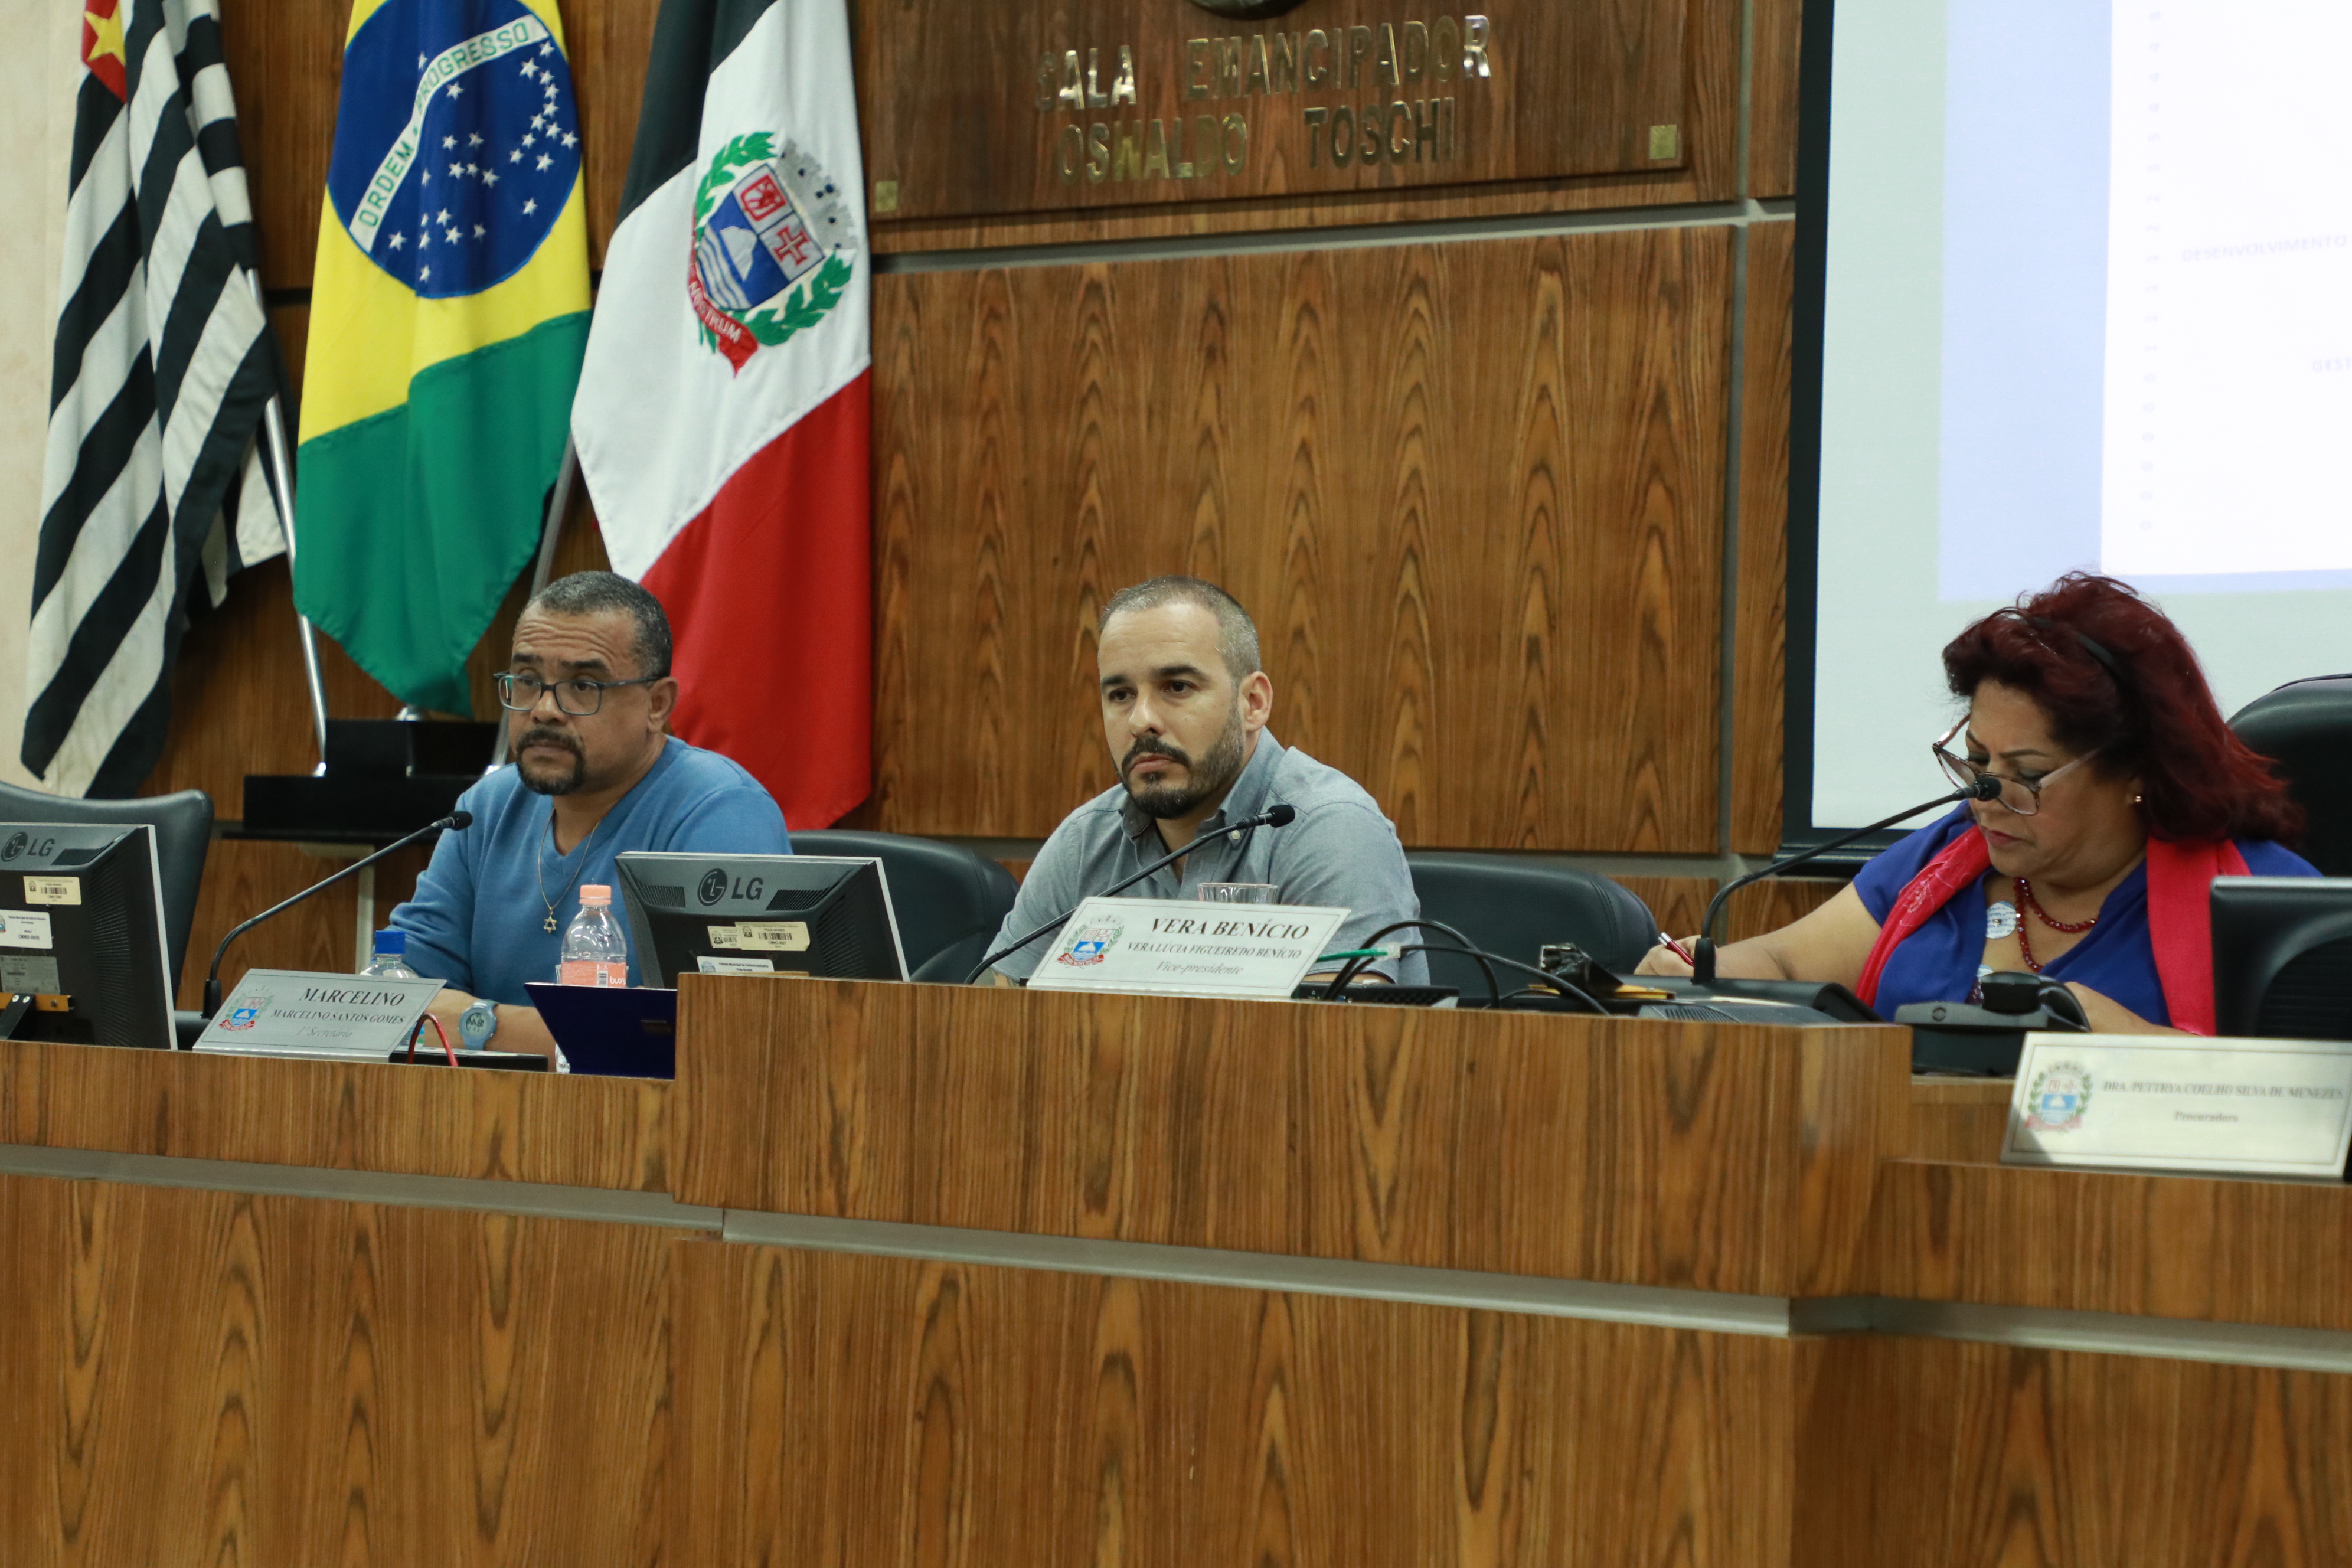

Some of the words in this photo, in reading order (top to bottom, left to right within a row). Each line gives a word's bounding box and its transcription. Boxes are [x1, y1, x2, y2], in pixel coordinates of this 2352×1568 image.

[1035, 45, 1137, 111] SALA
[1187, 14, 1492, 100] EMANCIPADOR
[358, 140, 414, 228] ORDEM
[415, 22, 530, 116] PROGRESSO
[1057, 112, 1247, 185] OSWALDO
[1304, 97, 1455, 169] TOSCHI
[2181, 234, 2347, 262] DESENVOLVIMENTO
[688, 280, 742, 344] NOSTRUM
[27, 838, 55, 857] LG
[731, 877, 764, 901] LG
[1152, 917, 1208, 936] VERA
[1212, 918, 1310, 940] BENÍCIO
[1128, 942, 1154, 952] VERA
[1155, 941, 1188, 953] LÚCIA
[1189, 944, 1255, 957] FIGUEIREDO
[1255, 946, 1302, 959] BENÍCIO
[1157, 961, 1244, 975] Vice-presidente
[299, 988, 405, 1007] MARCELINO
[271, 1009, 331, 1020] MARCELINO
[330, 1012, 367, 1023] SANTOS
[369, 1014, 406, 1025] GOMES
[311, 1027, 353, 1038] Secretário
[2184, 1083, 2234, 1096] COELHO
